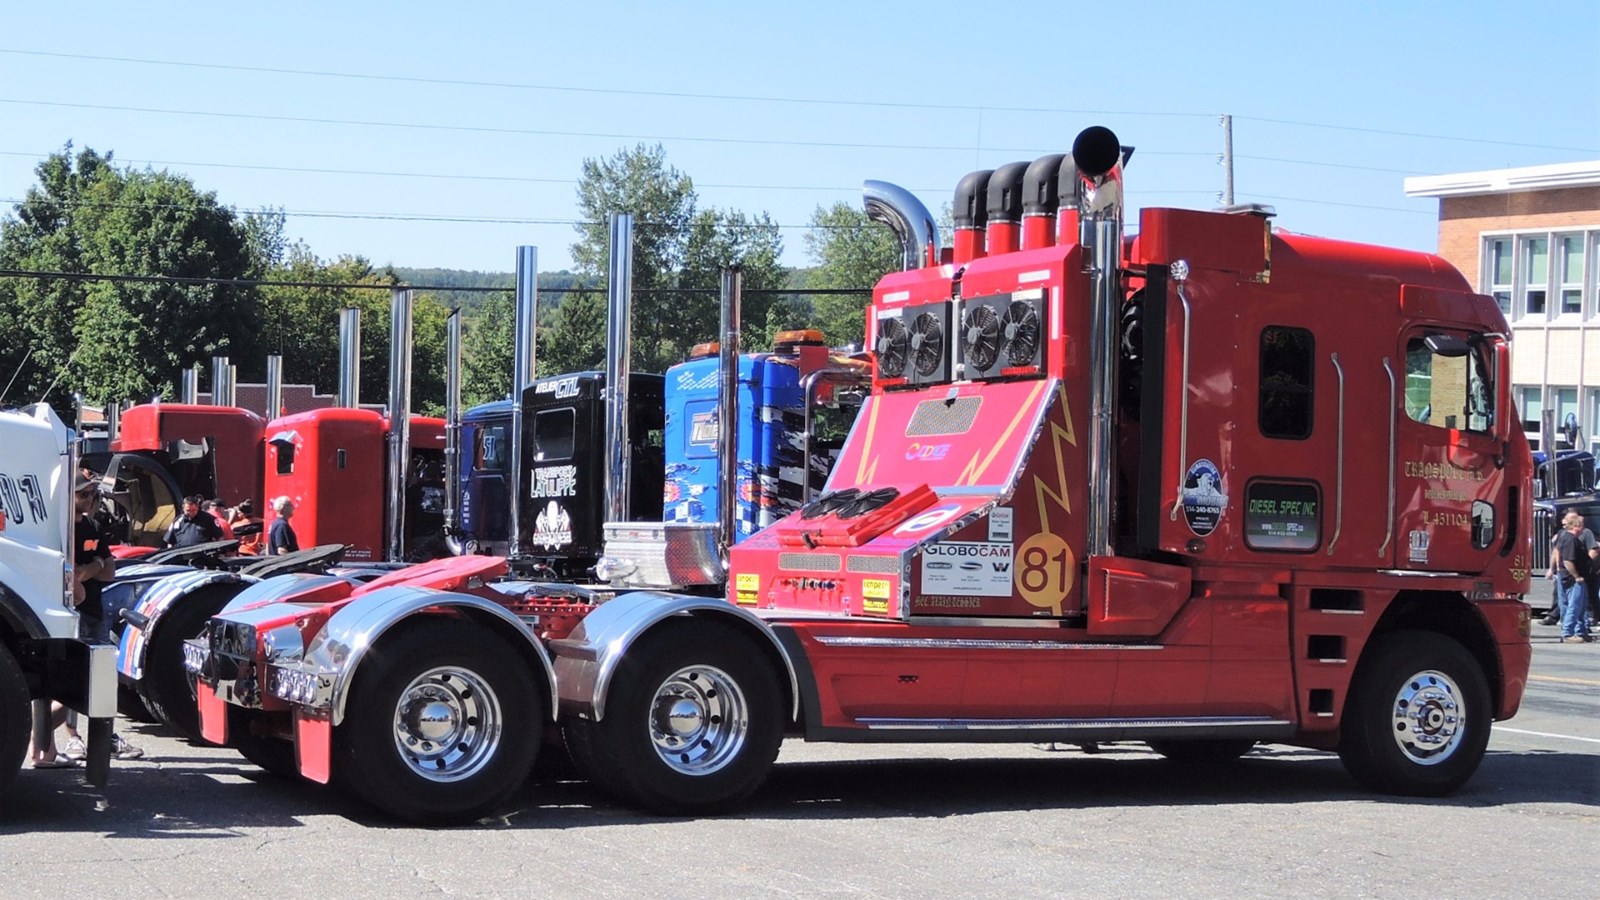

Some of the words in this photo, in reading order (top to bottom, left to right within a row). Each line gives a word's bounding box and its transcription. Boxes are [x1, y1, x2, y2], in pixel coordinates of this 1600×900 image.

[555, 376, 580, 399] CTL
[0, 473, 48, 525] 01
[1249, 499, 1278, 513] DIESEL
[1279, 501, 1301, 514] SPEC
[1302, 502, 1316, 515] INC
[925, 544, 1011, 558] GLOBOCAM
[1021, 546, 1066, 593] 81
[1514, 555, 1525, 567] 81
